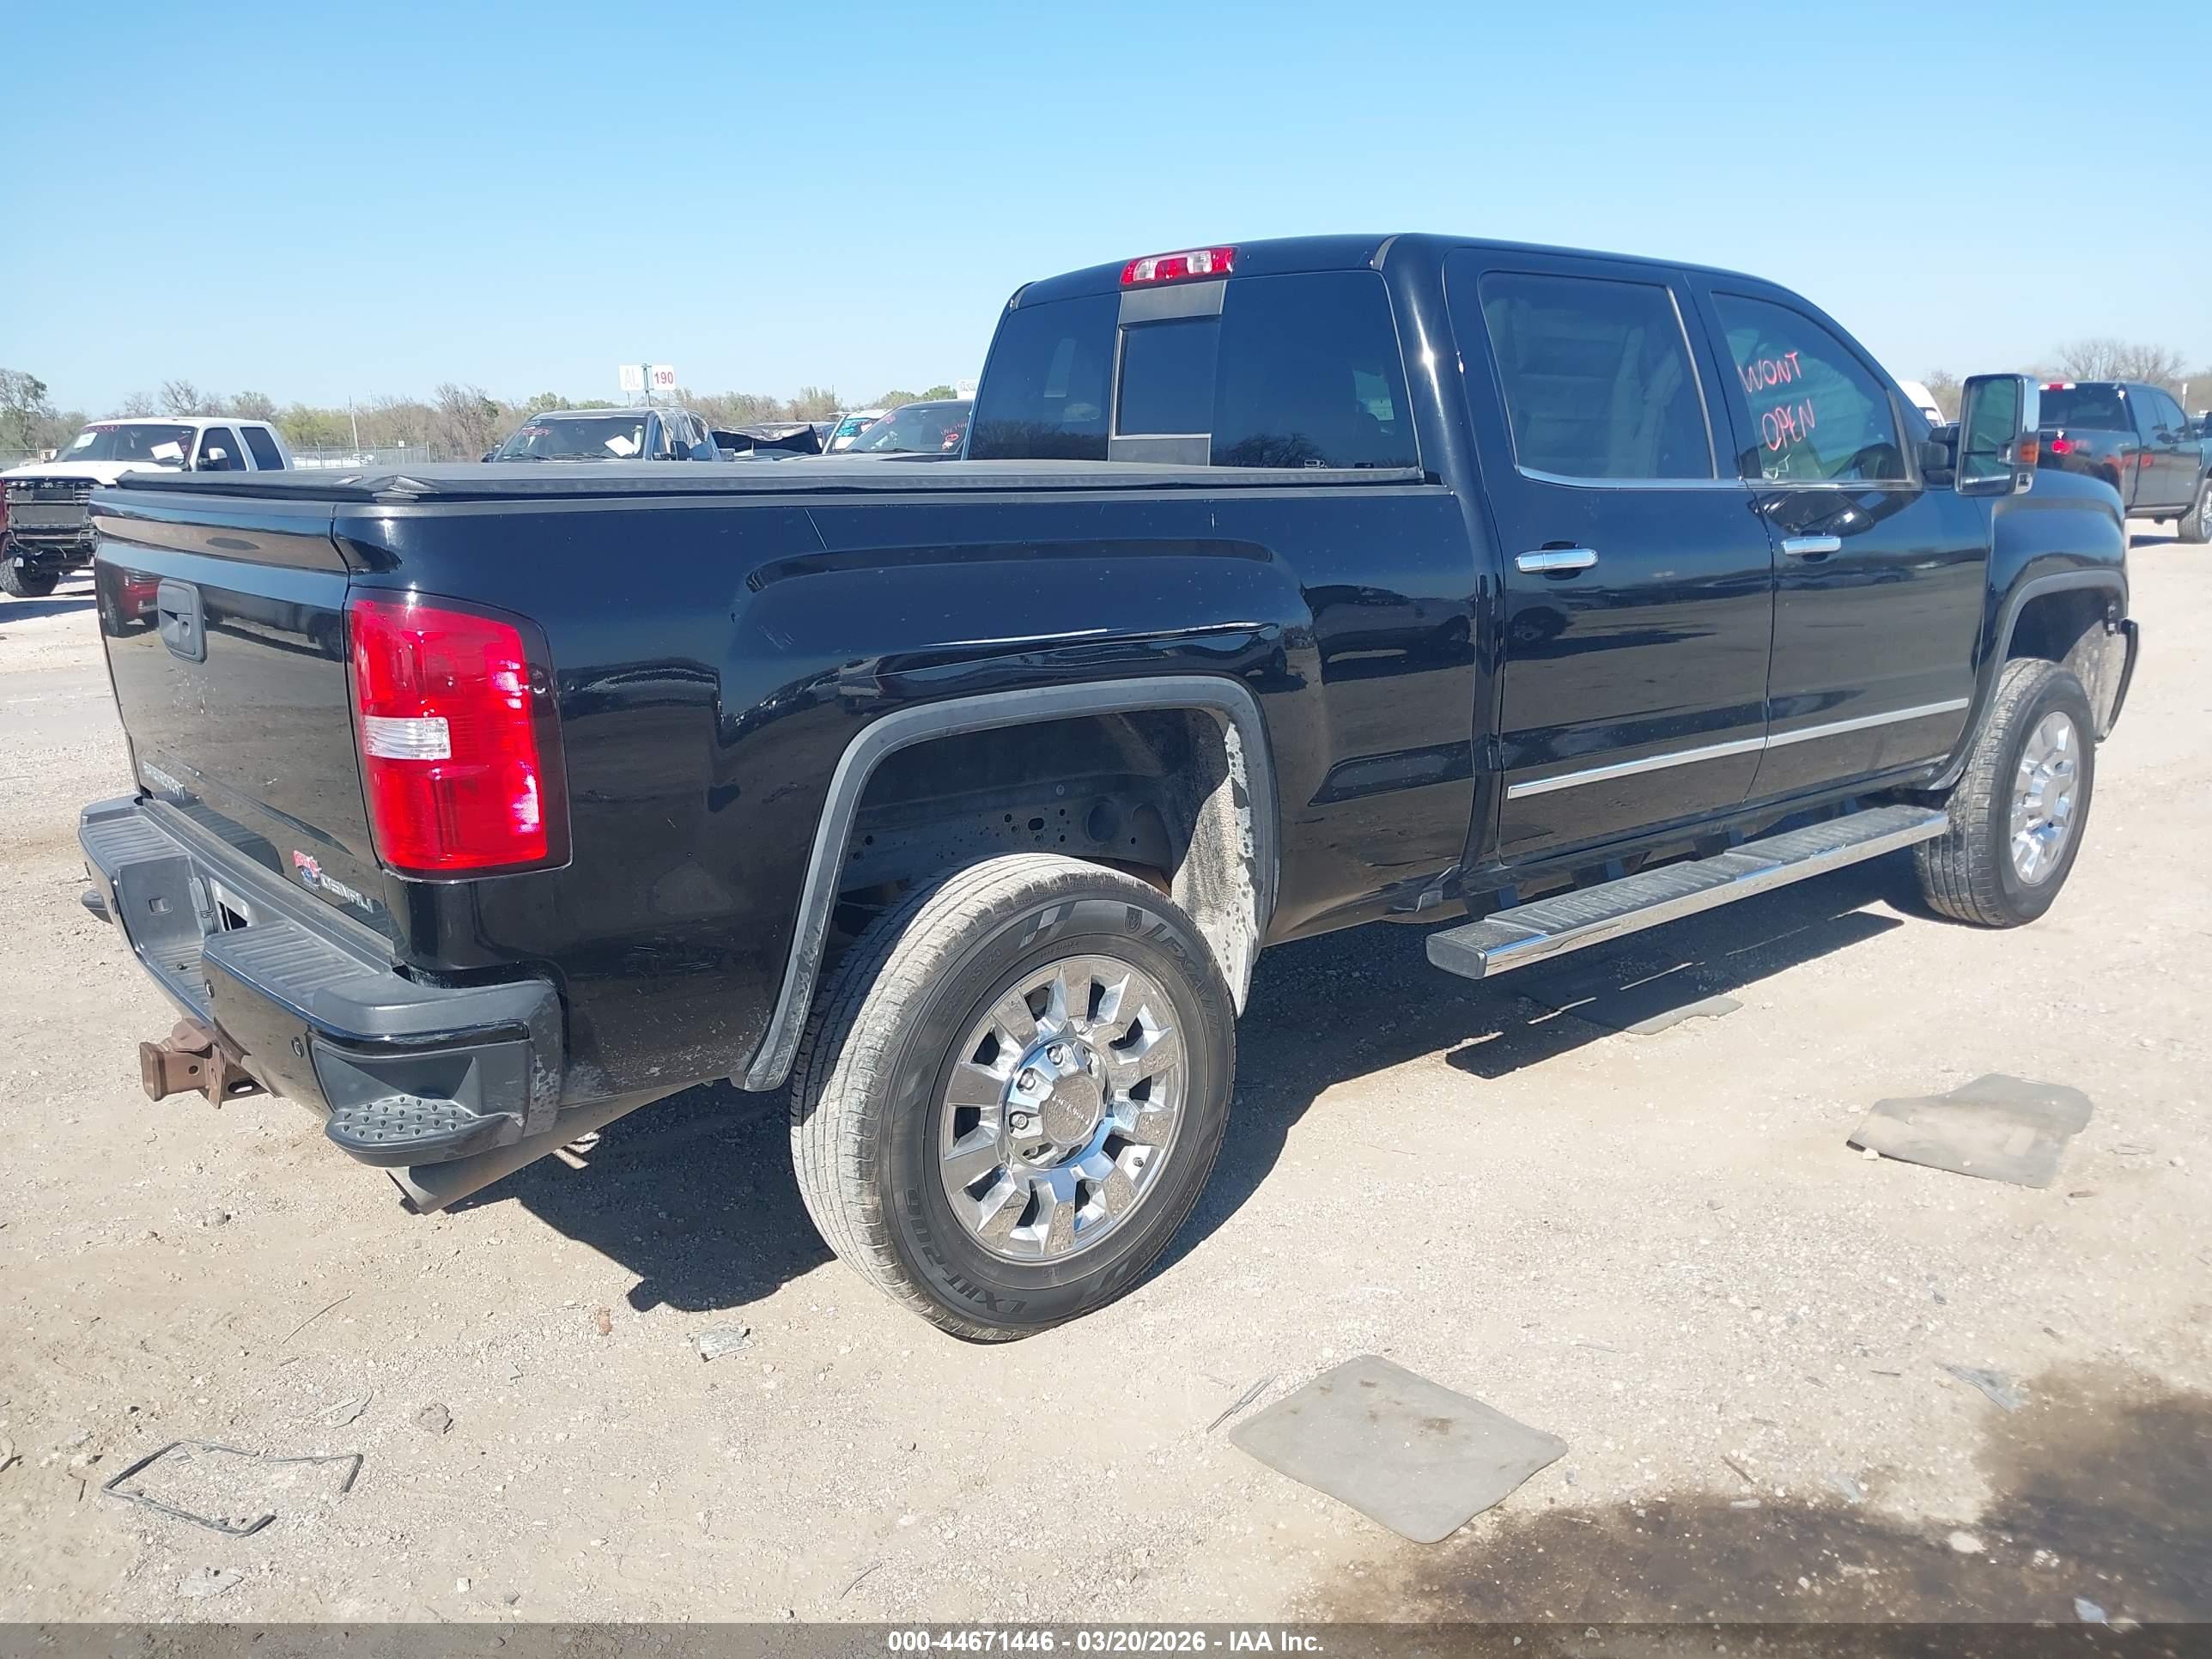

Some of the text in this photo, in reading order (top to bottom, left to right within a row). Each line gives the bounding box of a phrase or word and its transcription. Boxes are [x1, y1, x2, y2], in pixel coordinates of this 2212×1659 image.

[654, 371, 674, 385] 190
[1737, 351, 1802, 392] WONT
[1762, 398, 1815, 451] OPEN
